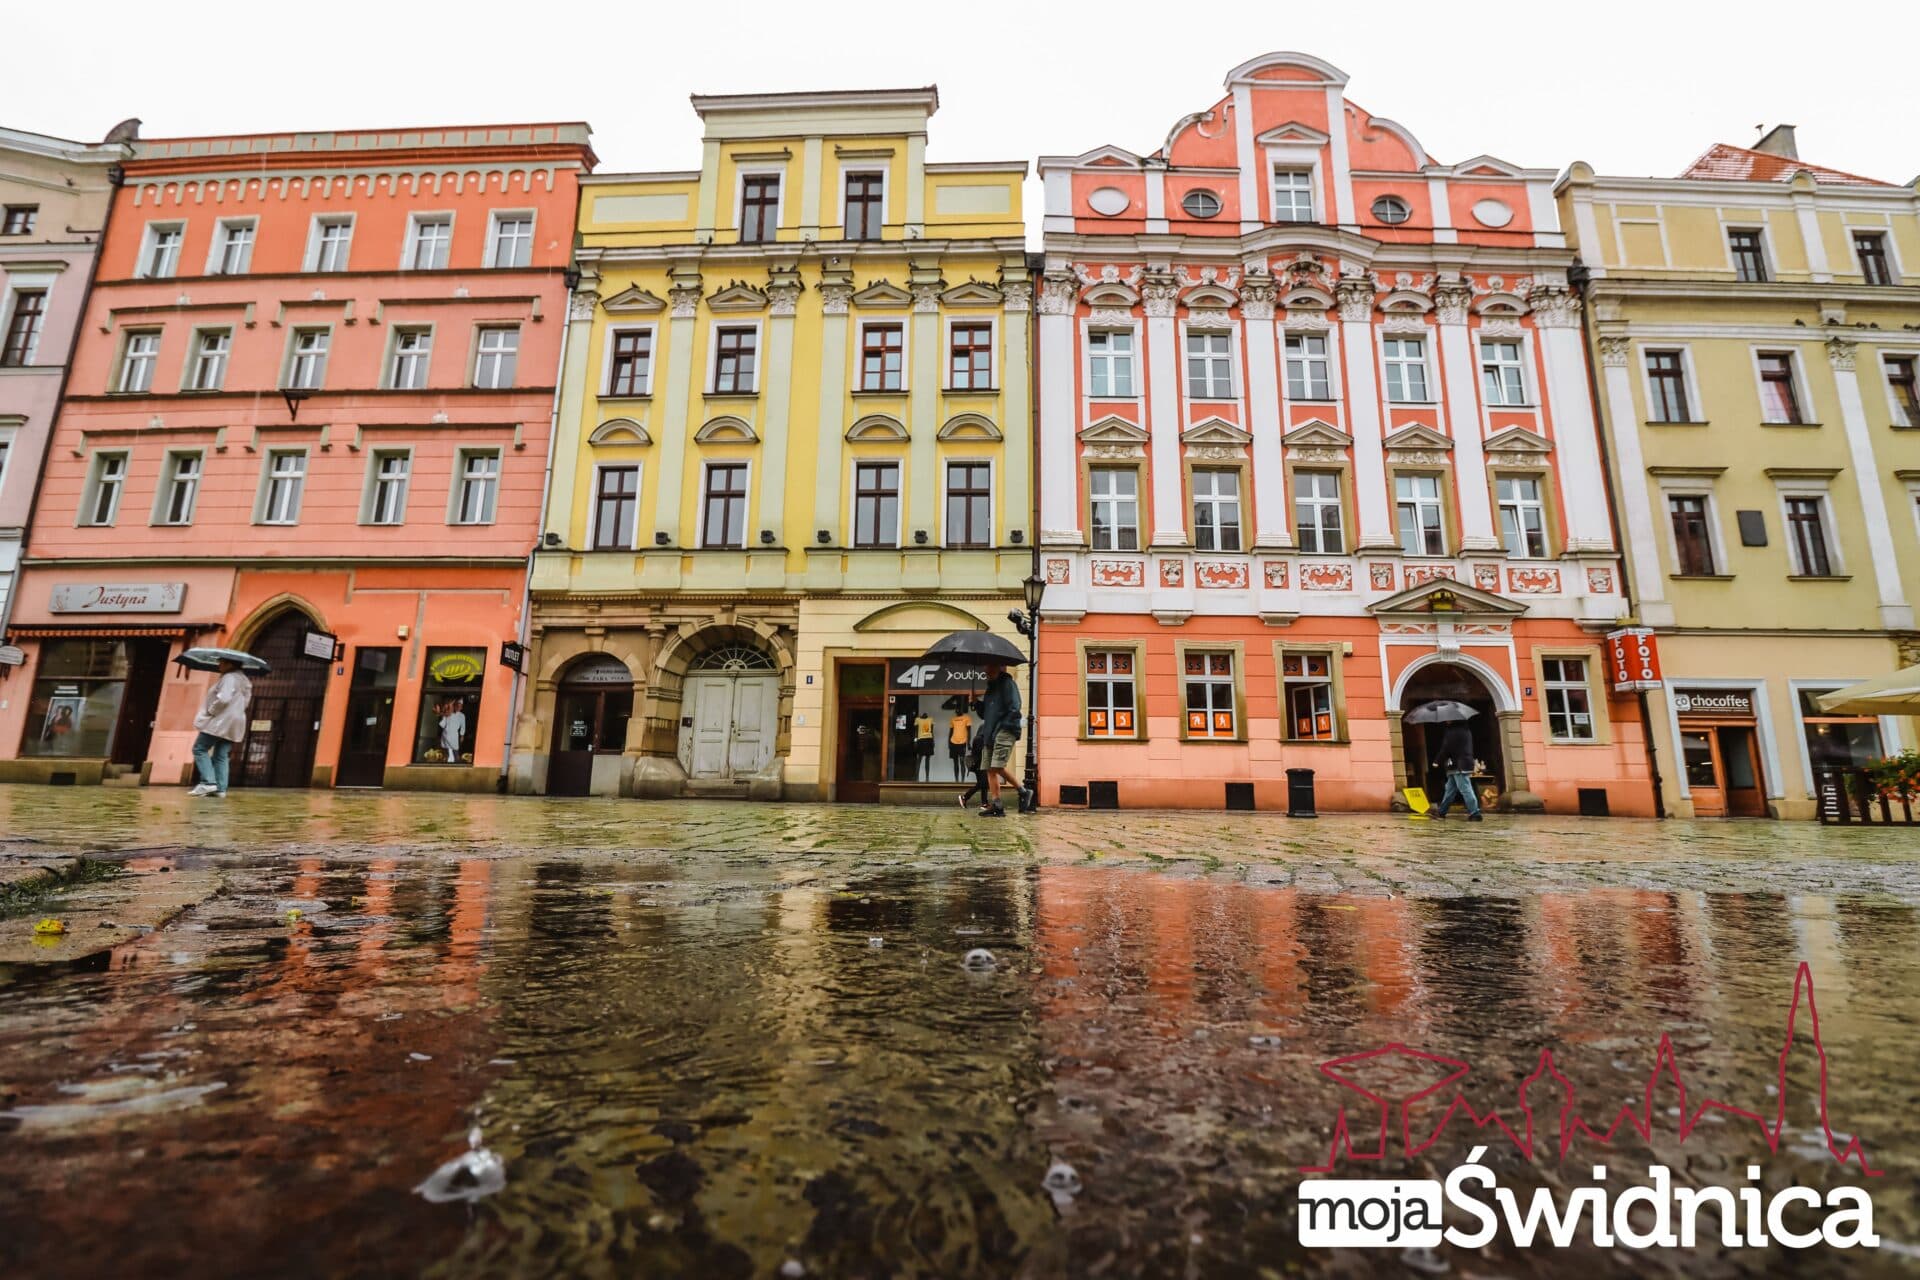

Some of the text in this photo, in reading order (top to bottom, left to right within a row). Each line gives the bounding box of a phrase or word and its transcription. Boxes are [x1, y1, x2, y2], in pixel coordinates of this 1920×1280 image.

[82, 586, 147, 608] Justyna
[1615, 636, 1628, 682] FOTO
[1637, 635, 1653, 680] FOTO
[897, 664, 940, 687] 4F
[1690, 694, 1750, 707] chocoffee
